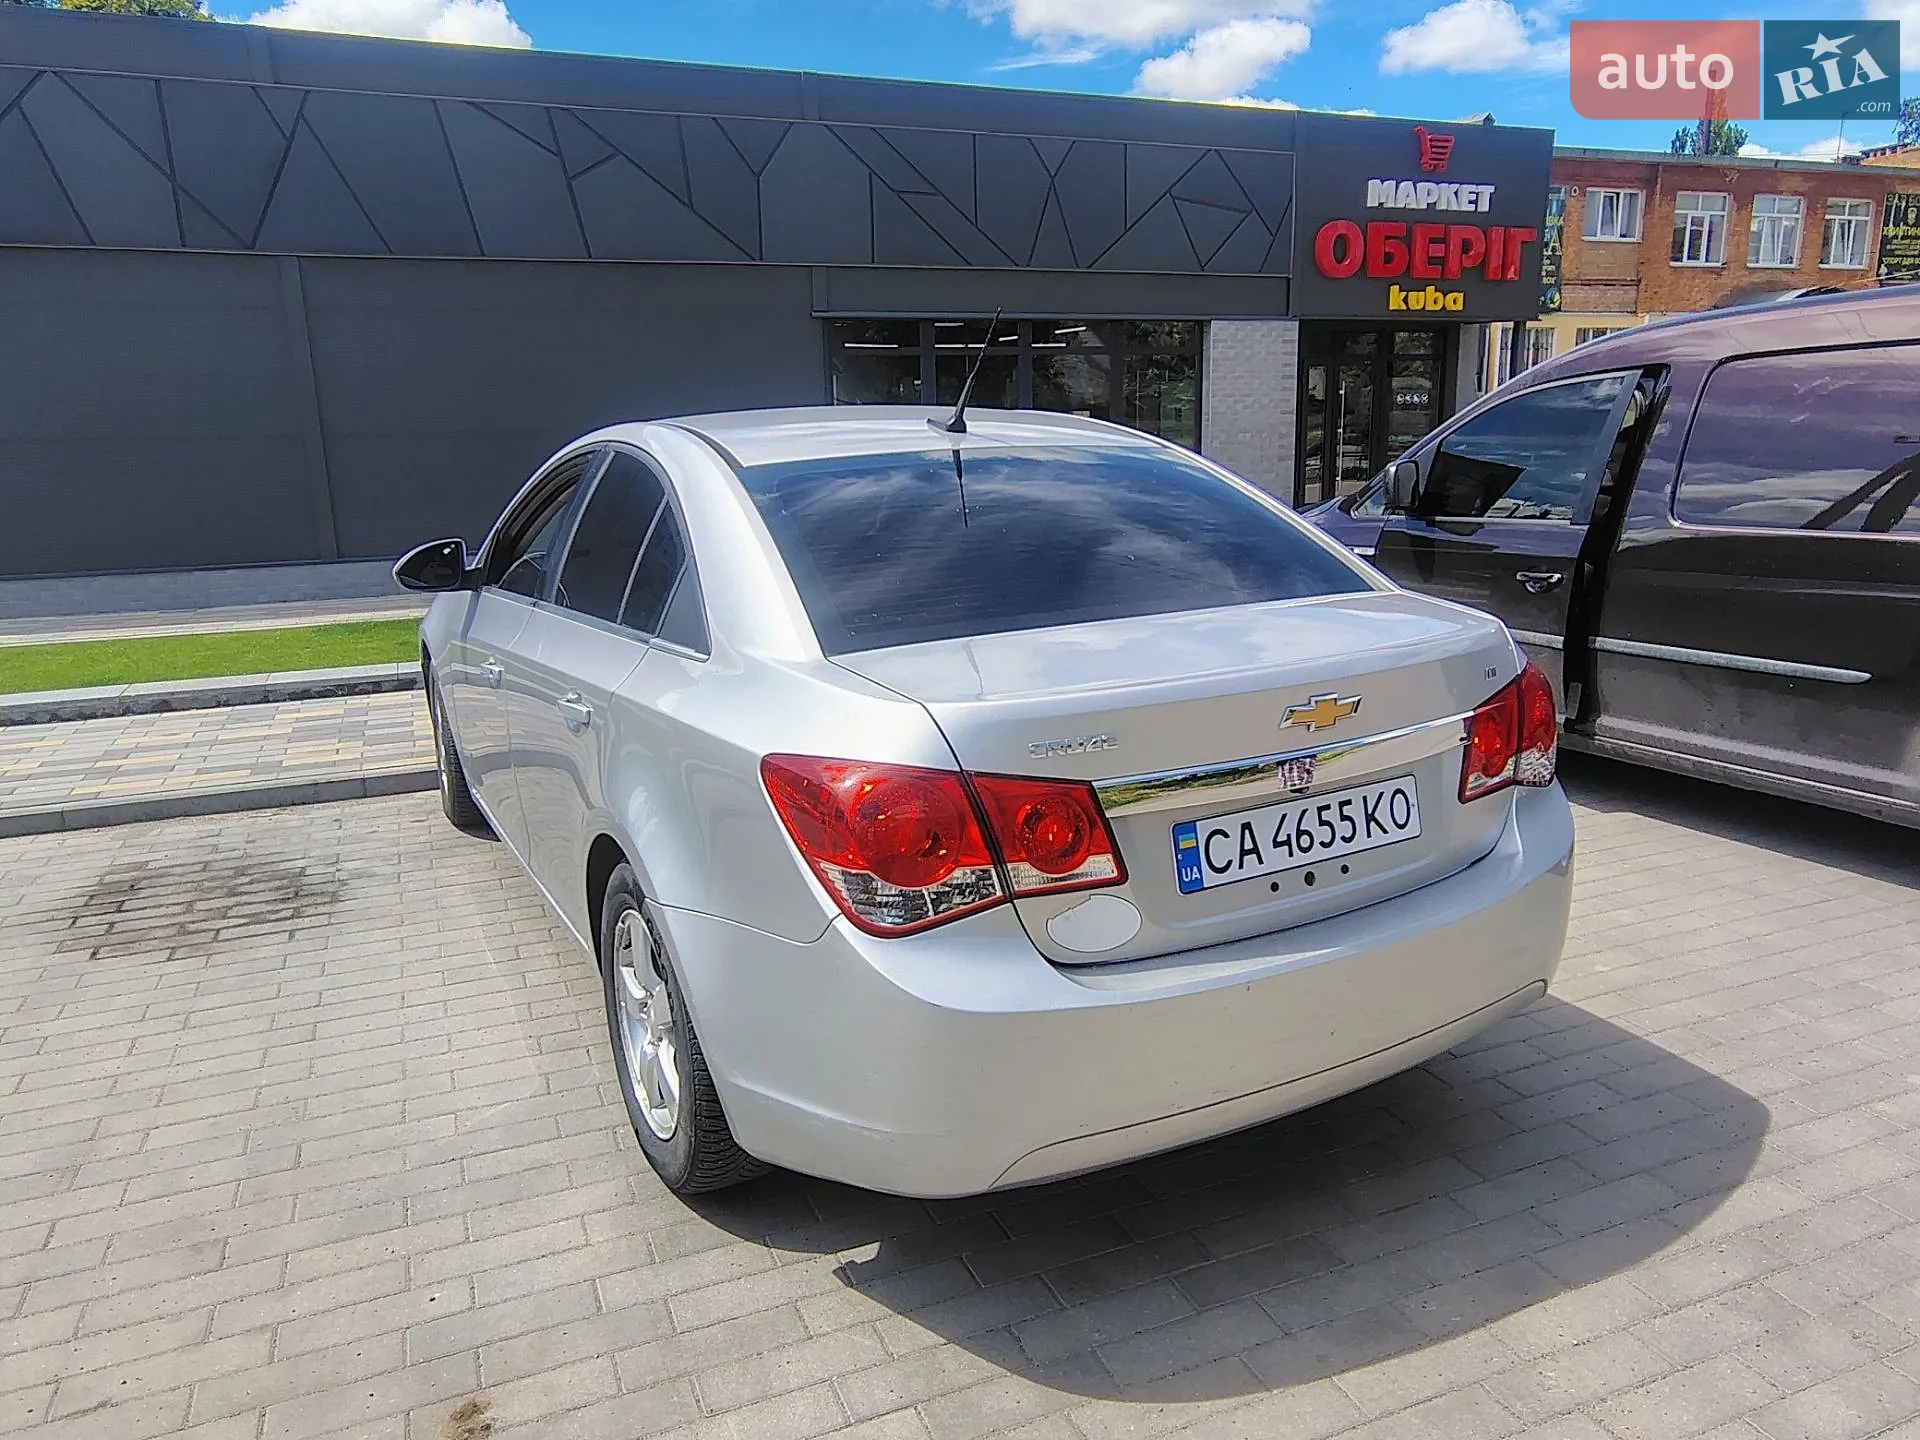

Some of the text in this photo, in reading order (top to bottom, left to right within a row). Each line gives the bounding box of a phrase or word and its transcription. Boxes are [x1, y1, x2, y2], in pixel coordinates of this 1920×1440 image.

[1366, 178, 1496, 213] МАРКЕТ
[1314, 218, 1538, 281] ОБЕРІГ
[1389, 284, 1465, 312] kuba
[1028, 733, 1119, 759] CRUZE
[1204, 788, 1411, 875] CA 4655 KO
[1182, 866, 1200, 882] UA
